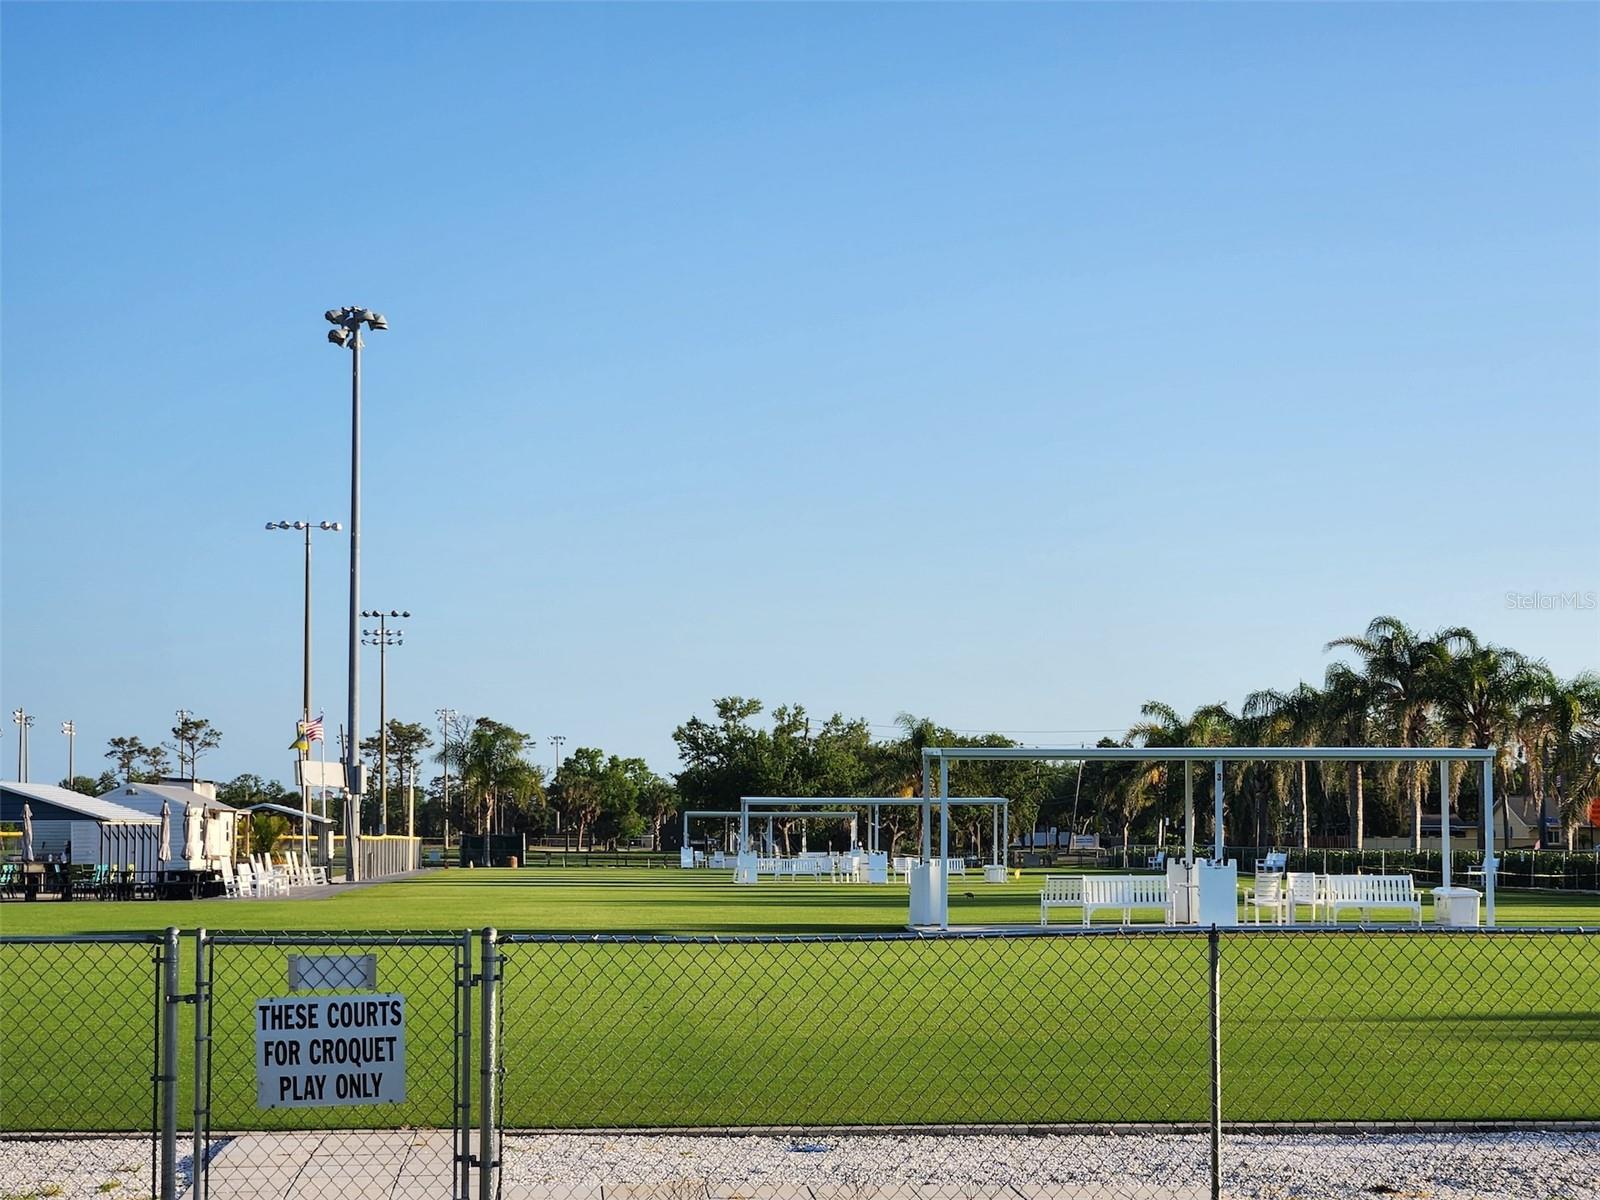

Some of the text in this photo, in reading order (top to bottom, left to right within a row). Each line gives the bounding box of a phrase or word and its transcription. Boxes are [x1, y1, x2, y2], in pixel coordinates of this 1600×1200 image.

[259, 1001, 402, 1030] THESE COURTS
[264, 1037, 397, 1068] FOR CROQUET
[280, 1073, 383, 1101] PLAY ONLY
